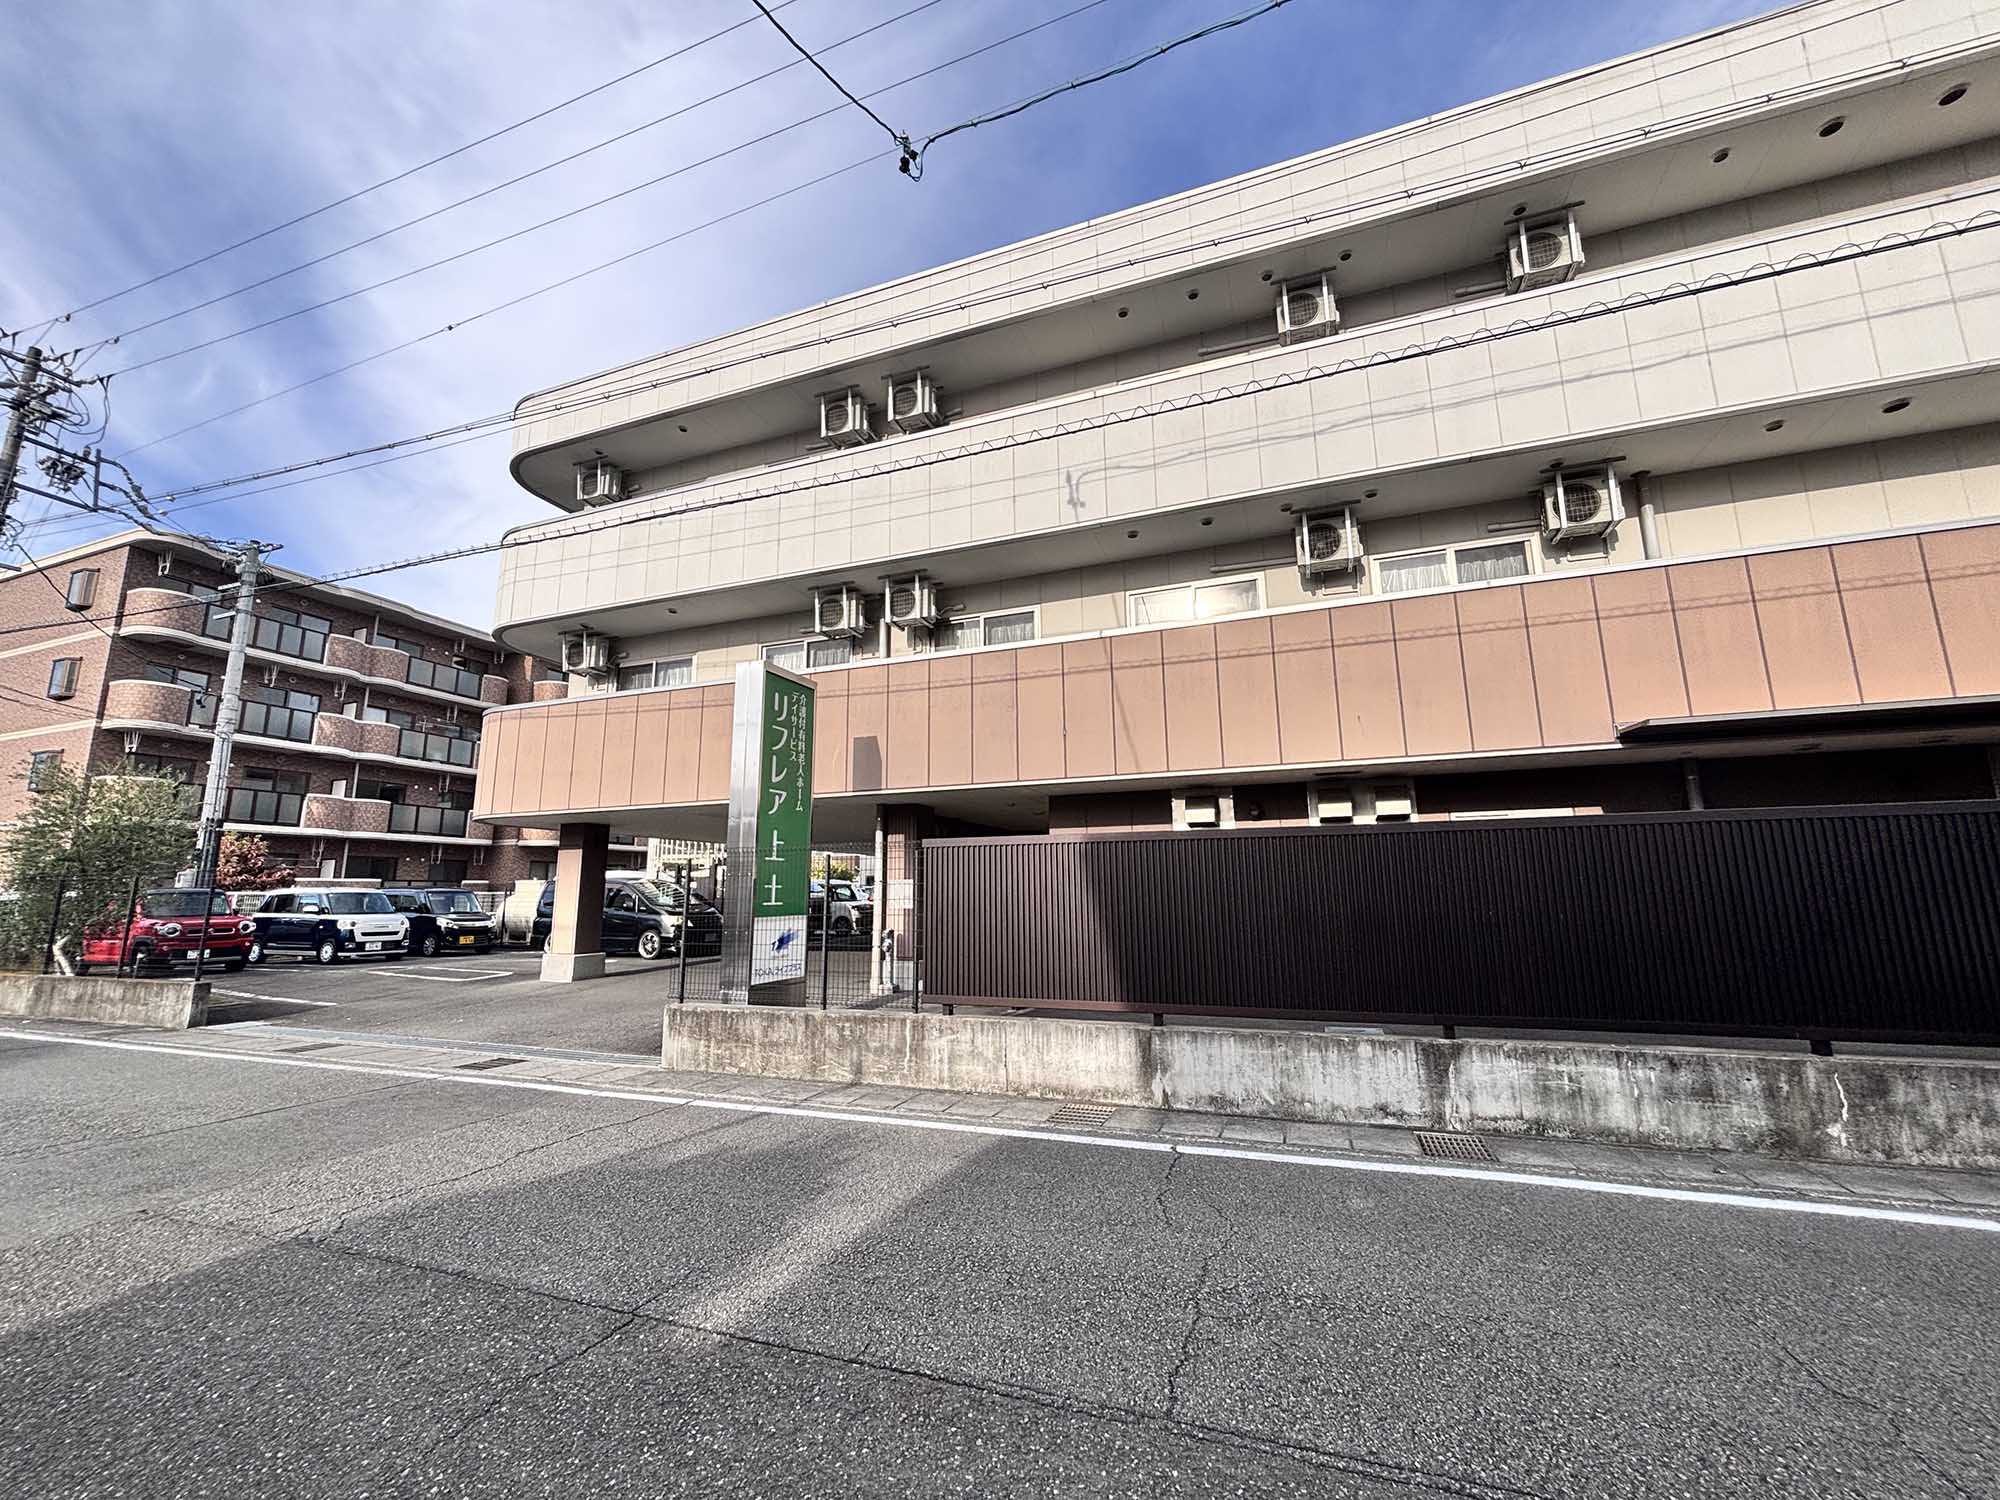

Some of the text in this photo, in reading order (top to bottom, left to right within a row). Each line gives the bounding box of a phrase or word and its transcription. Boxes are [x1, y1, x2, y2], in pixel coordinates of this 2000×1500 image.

[790, 691, 799, 761] デイサービス
